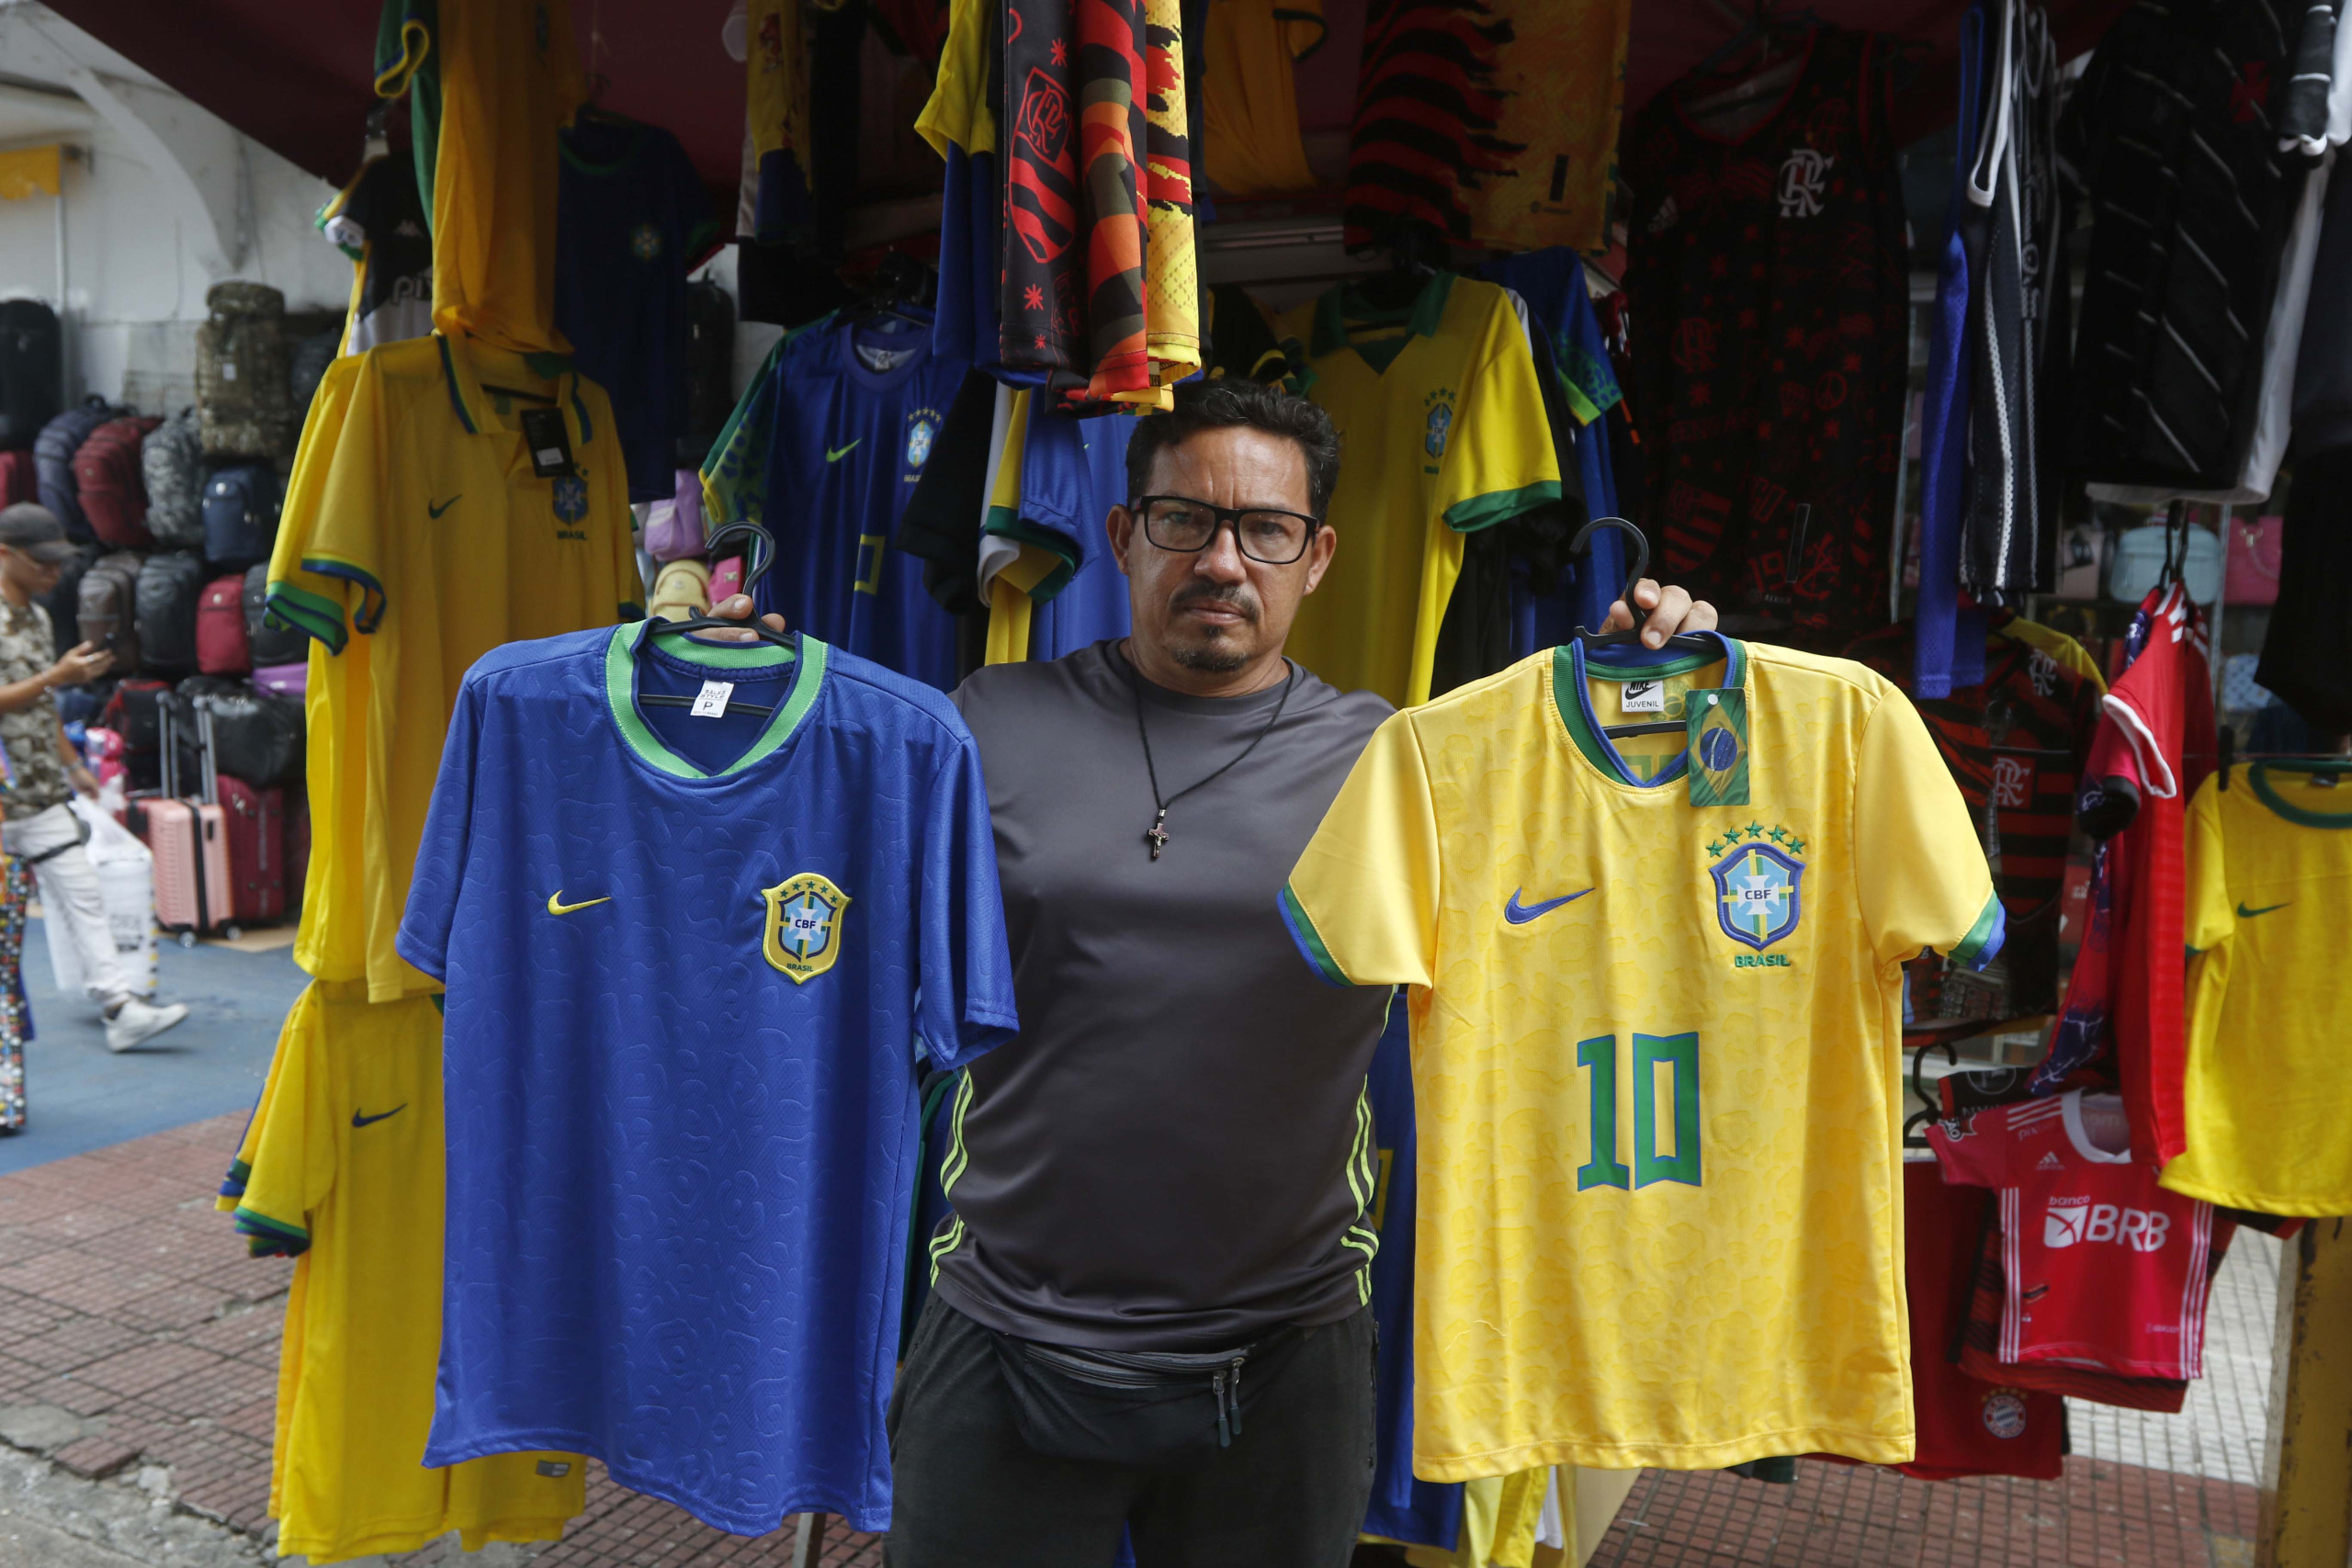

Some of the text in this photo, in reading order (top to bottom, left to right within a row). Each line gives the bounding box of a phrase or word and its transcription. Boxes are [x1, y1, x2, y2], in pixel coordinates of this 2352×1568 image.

[1629, 680, 1650, 691] NIKE
[702, 701, 714, 711] P
[1625, 700, 1659, 708] JUVENIL
[1745, 889, 1772, 900] CBF
[795, 919, 817, 930] CBF
[1734, 953, 1792, 967] BRASIL
[786, 963, 814, 973] BRASIL
[1577, 1032, 1702, 1192] 10
[2048, 1195, 2091, 1206] banco
[2086, 1203, 2171, 1252] BRB
